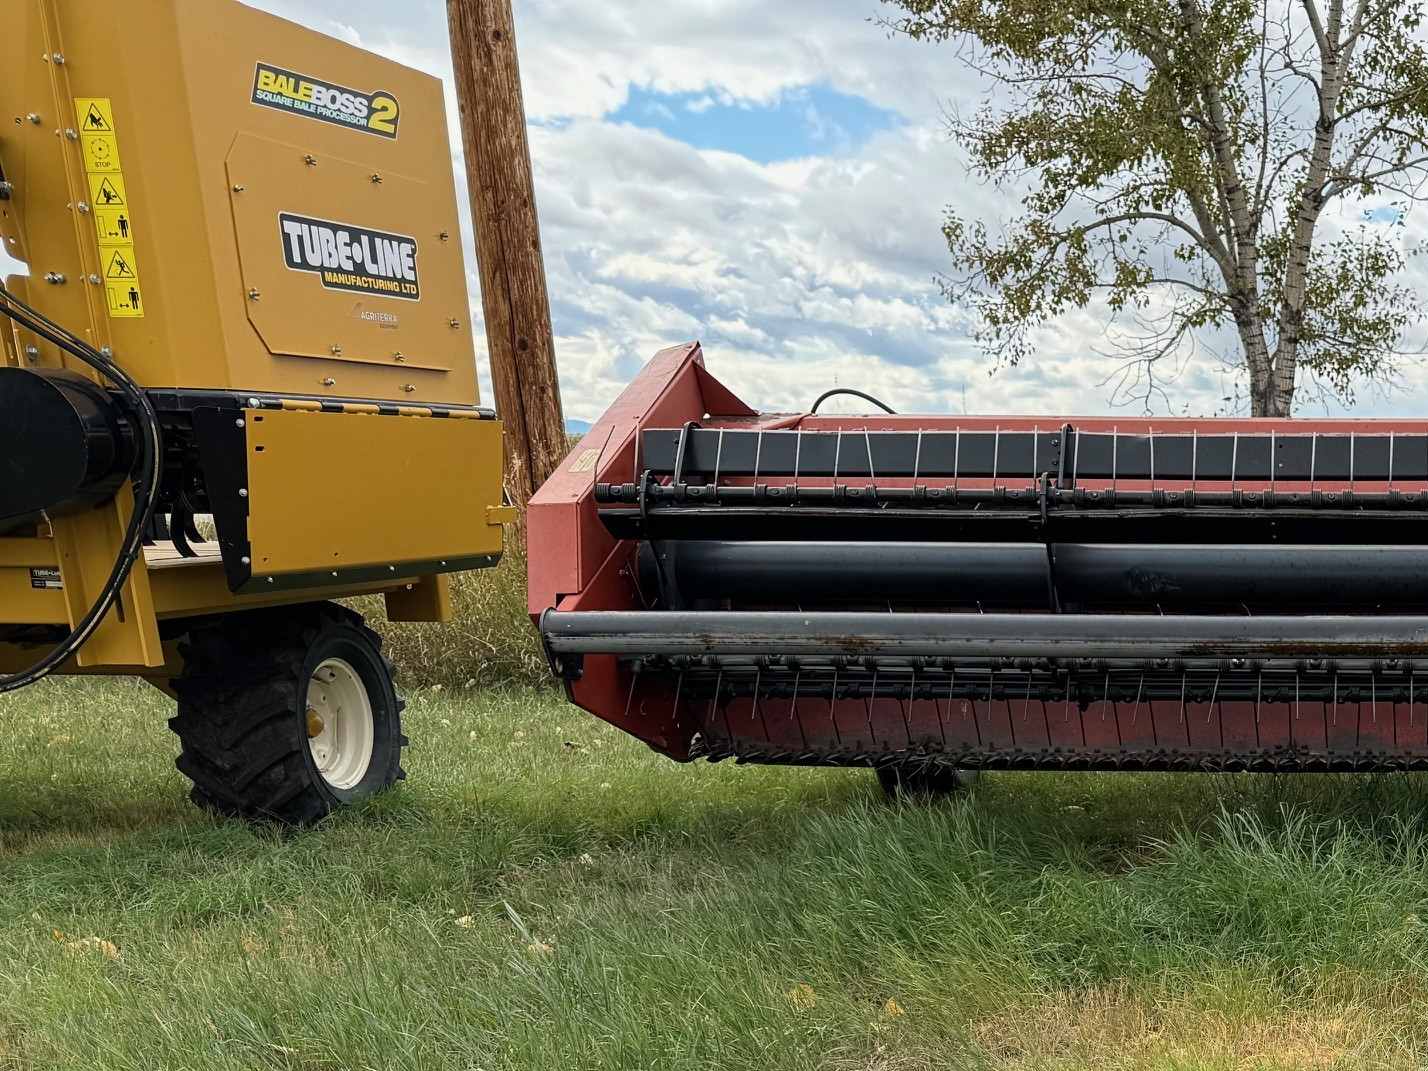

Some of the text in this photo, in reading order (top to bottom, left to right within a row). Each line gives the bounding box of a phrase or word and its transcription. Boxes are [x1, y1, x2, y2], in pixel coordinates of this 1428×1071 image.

[256, 89, 368, 127] SQUARE BALE PROCESSOR
[257, 69, 398, 134] BALEBOSS 2
[95, 161, 111, 169] STOP
[324, 271, 417, 295] MANUFACTURING LTD
